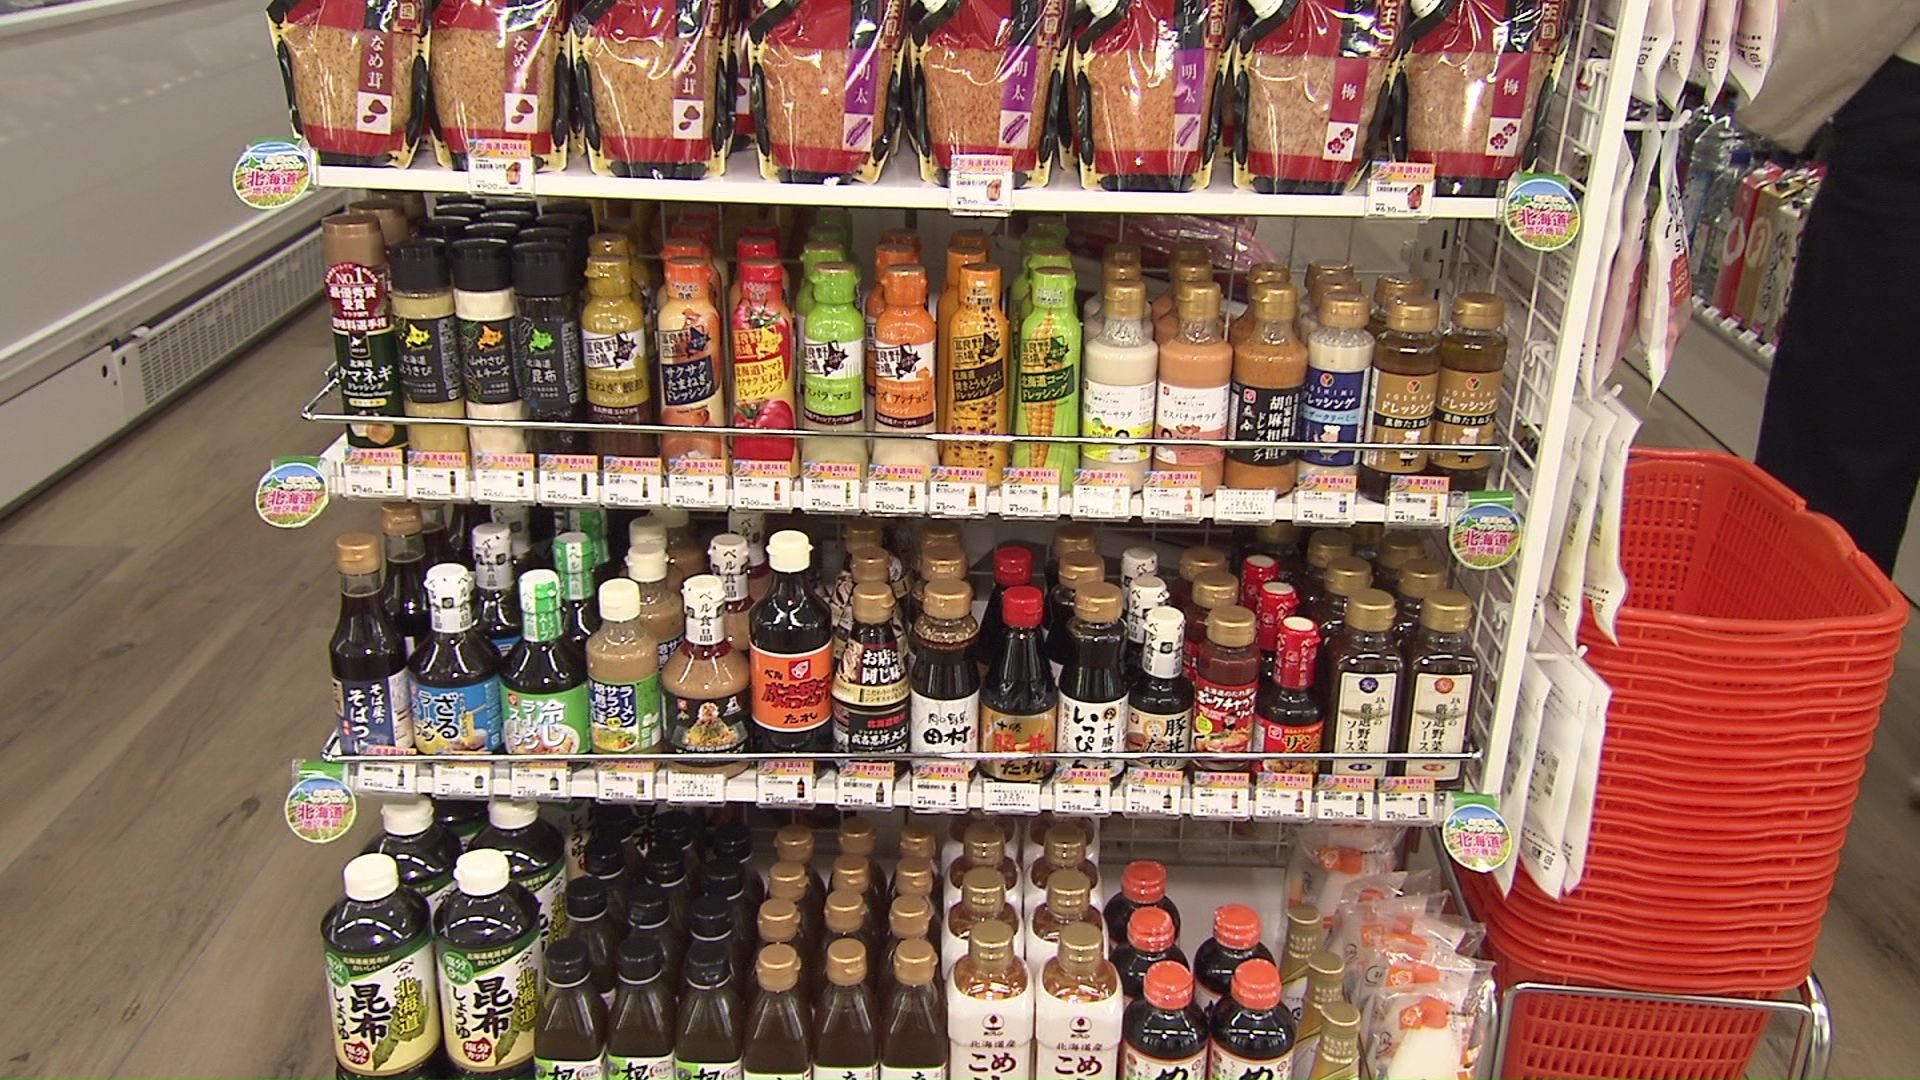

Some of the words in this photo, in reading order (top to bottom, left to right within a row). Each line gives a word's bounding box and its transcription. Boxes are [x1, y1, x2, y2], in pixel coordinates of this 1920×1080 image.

[368, 35, 385, 90] なめ茸
[1011, 60, 1028, 102] 明太
[1181, 64, 1197, 104] 明太
[1503, 78, 1519, 96] 梅
[1340, 84, 1357, 101] 梅
[246, 171, 297, 187] 北海道
[1520, 210, 1569, 227] 北海道
[585, 338, 618, 354] 富良野
[531, 368, 557, 384] 昆布
[666, 361, 707, 378] サクサク
[1022, 370, 1070, 387] 北海道コーン
[667, 374, 707, 391] たまねぎ
[667, 381, 713, 402] ドレッシング
[1023, 383, 1068, 399] ドレッシング
[1441, 395, 1496, 411] ドレッシング
[268, 490, 316, 505] 北海道
[1464, 529, 1511, 546] 北海道
[723, 547, 738, 598] ベル食品
[699, 590, 714, 642] ベル食品
[863, 648, 898, 666] お店と
[861, 665, 902, 684] 同じ味
[369, 683, 386, 724] そば屋の
[605, 685, 621, 717] サラダ
[619, 686, 635, 726] ラーメン
[418, 690, 436, 742] ラーメン
[434, 692, 460, 740] ざる
[520, 699, 541, 750] ラーメン
[539, 699, 567, 747] 冷し
[783, 711, 818, 724] たれ
[508, 707, 523, 747] スープ
[923, 724, 971, 746] 田村
[1345, 720, 1357, 751] ソース
[1419, 720, 1432, 751] ソース
[1000, 760, 1041, 776] たれ
[297, 804, 344, 819] 北海道
[1458, 833, 1501, 848] 北海道
[516, 967, 537, 1023] 北海道
[333, 987, 350, 1040] しょうゆ
[349, 983, 392, 1045] 昆布
[394, 977, 420, 1036] 北海道
[452, 985, 471, 1039] しょうゆ
[472, 976, 514, 1040] 昆布
[464, 1042, 491, 1054] 塩分
[970, 1039, 1017, 1049] 北海道産
[1055, 1041, 1103, 1051] 北海道産
[467, 1052, 490, 1062] カット
[968, 1051, 1017, 1074] こめ
[1054, 1055, 1103, 1077] こめ
